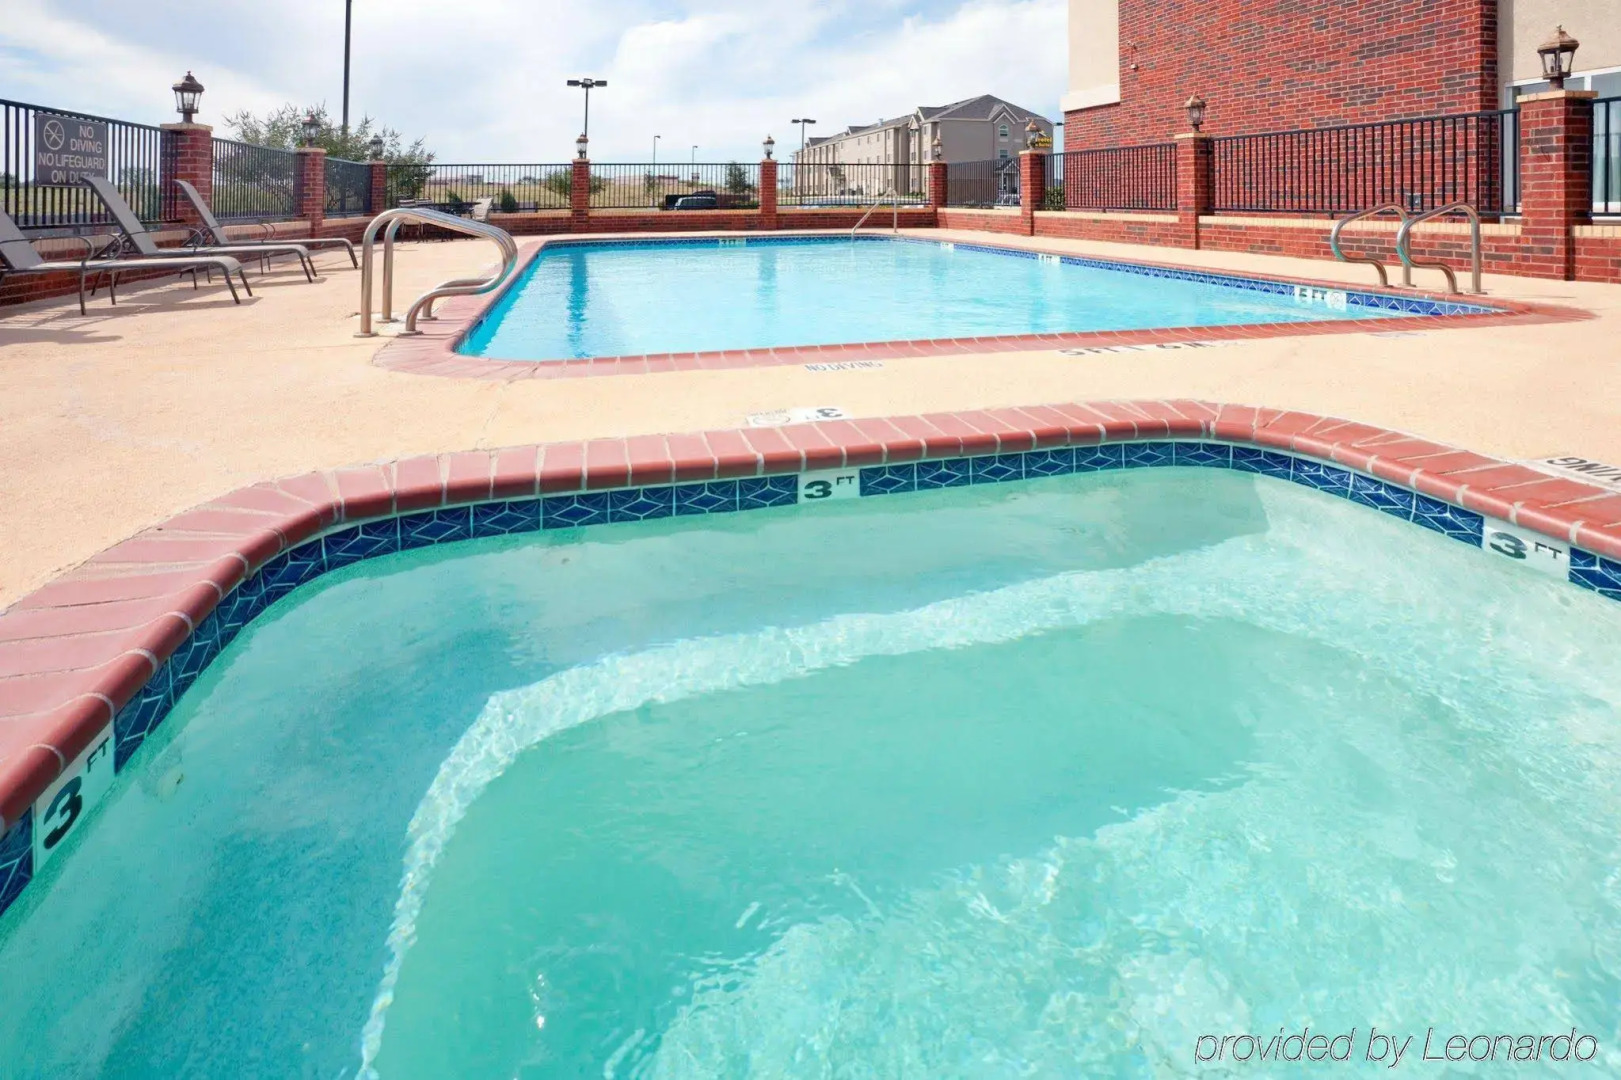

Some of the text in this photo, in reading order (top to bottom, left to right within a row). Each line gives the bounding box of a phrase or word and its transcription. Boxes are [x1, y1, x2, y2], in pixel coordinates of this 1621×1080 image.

[79, 125, 94, 138] NO
[70, 138, 103, 153] DIVING
[38, 152, 105, 169] NO LIFEGUARD
[51, 170, 66, 183] ON
[804, 475, 855, 499] 3 FT
[1489, 531, 1562, 560] 3 FT
[43, 736, 110, 850] 3 FT
